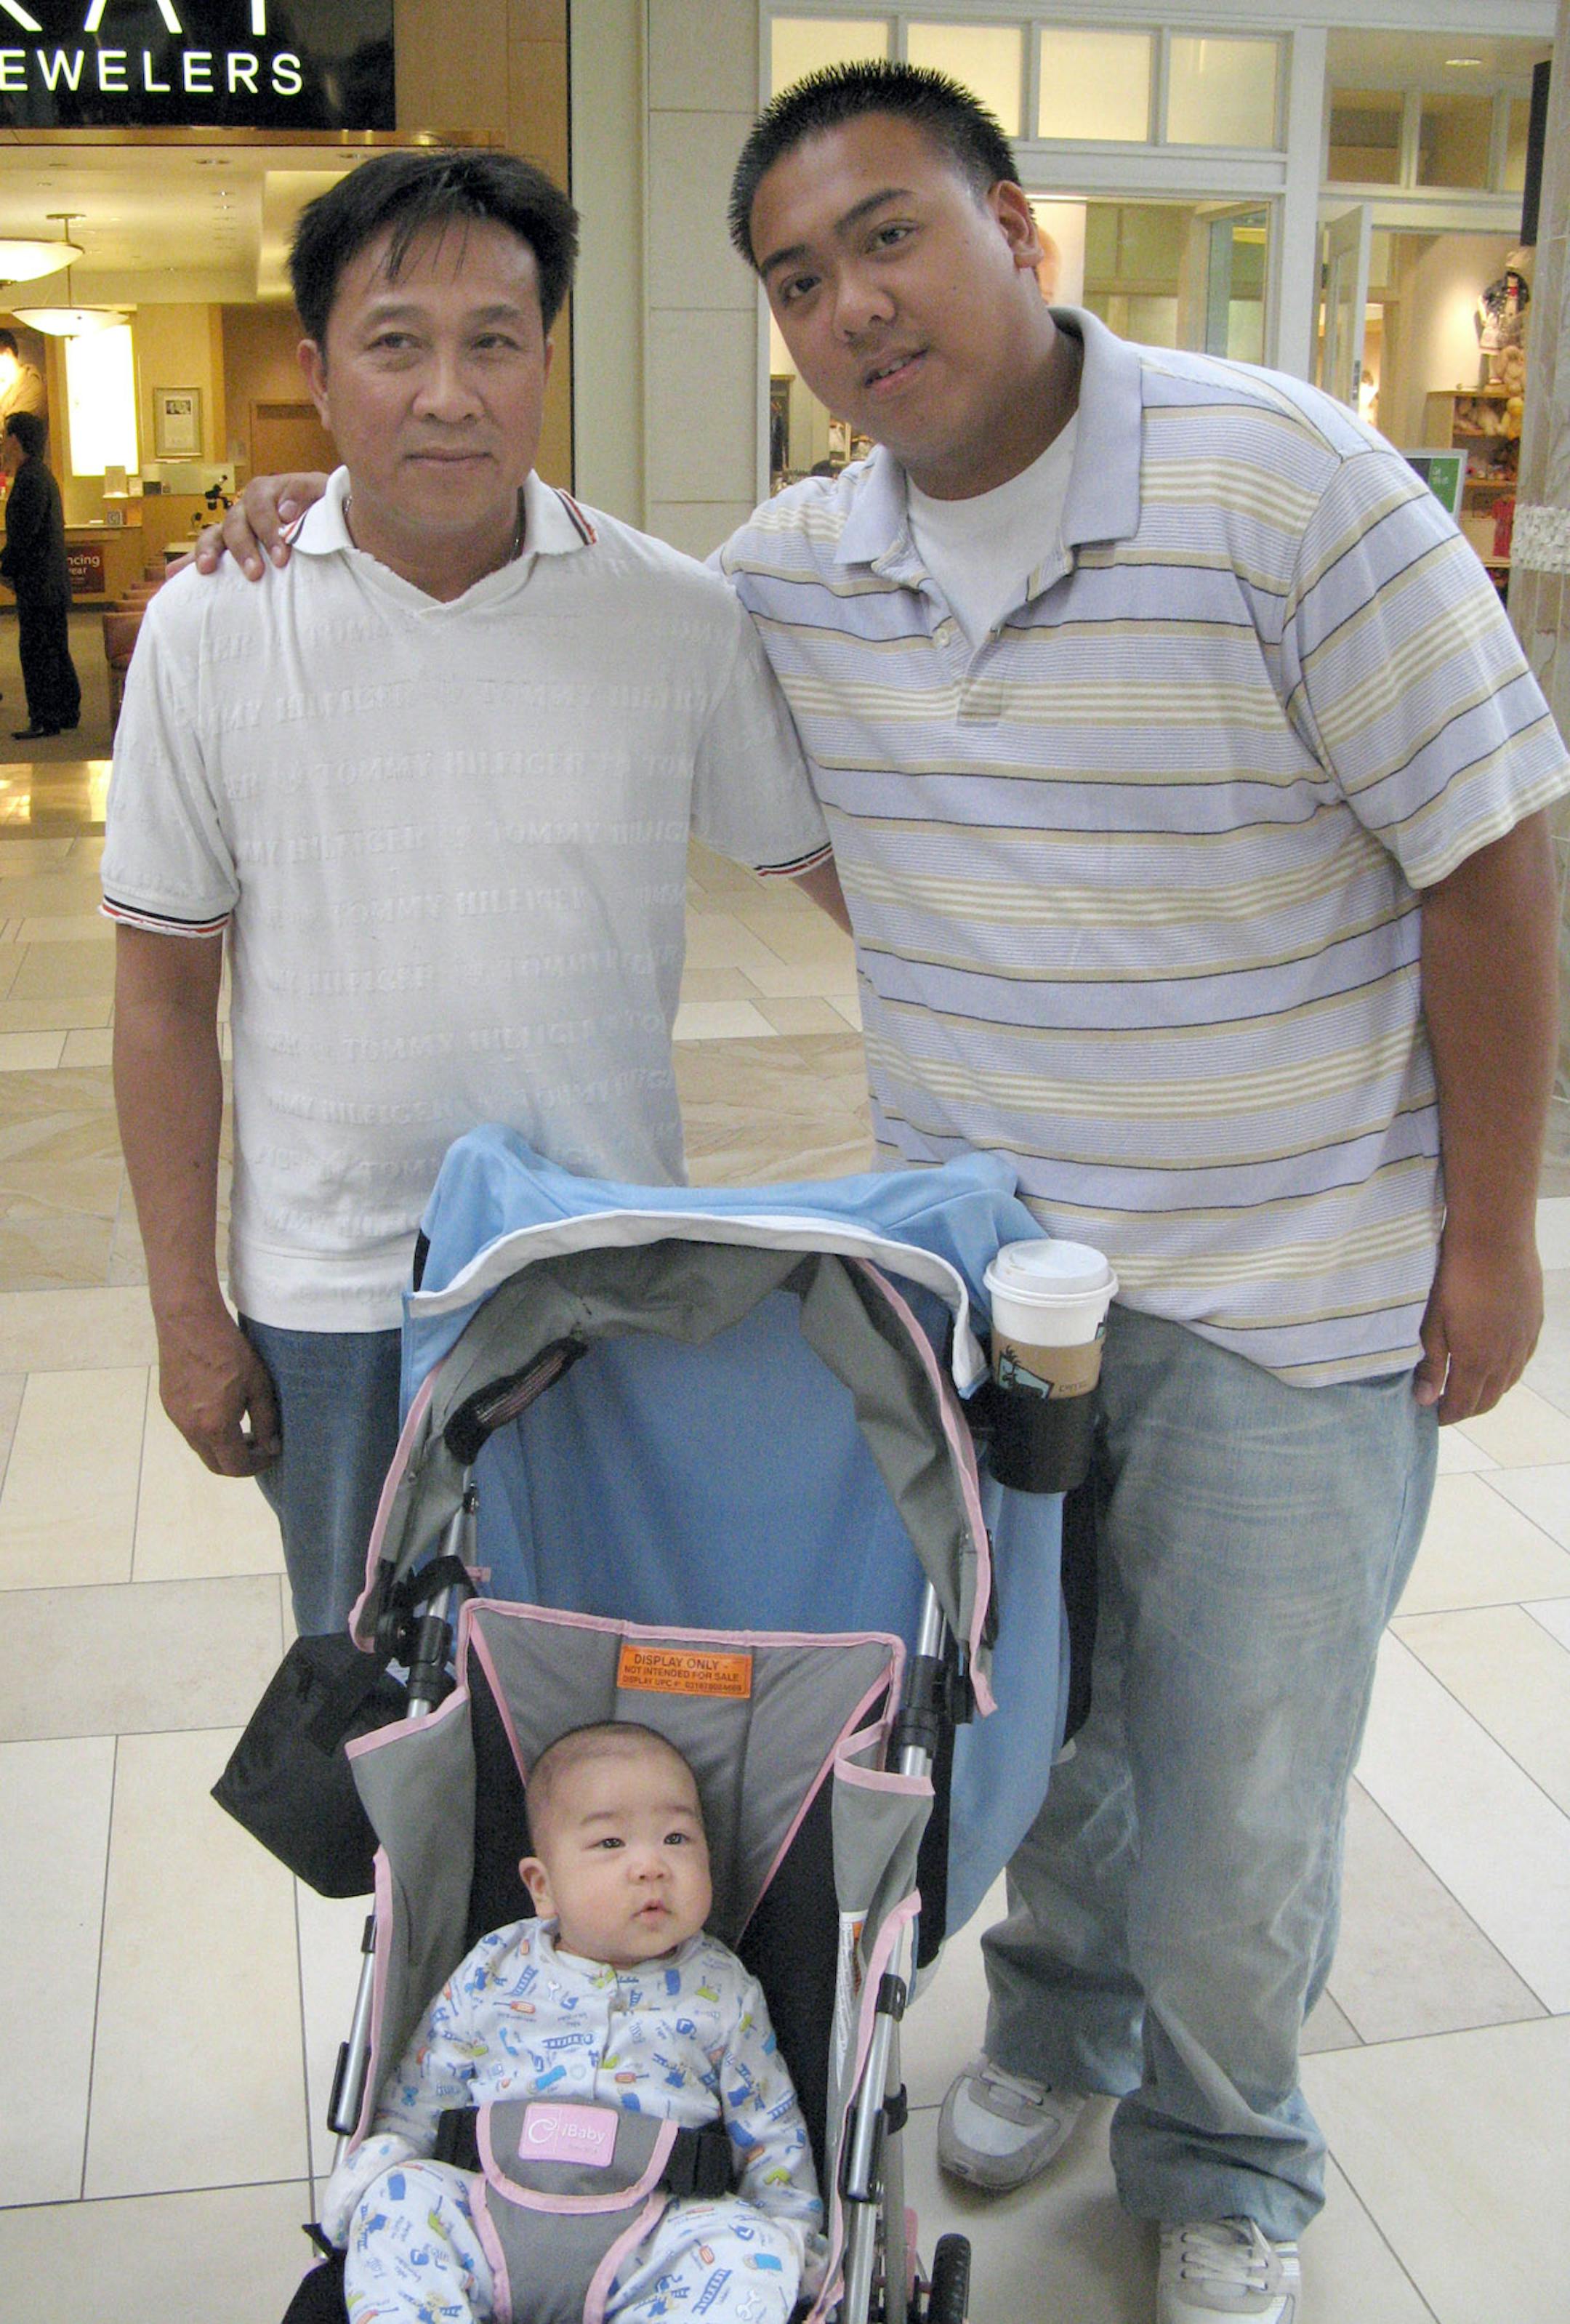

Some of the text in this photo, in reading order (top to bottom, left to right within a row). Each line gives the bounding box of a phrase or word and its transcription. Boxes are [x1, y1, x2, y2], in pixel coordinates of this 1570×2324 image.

[635, 1654, 720, 1670] DISPLAY ONLY
[624, 1665, 740, 1682] NOT INTENDED FOR SALE
[561, 2123, 605, 2144] iBaby
